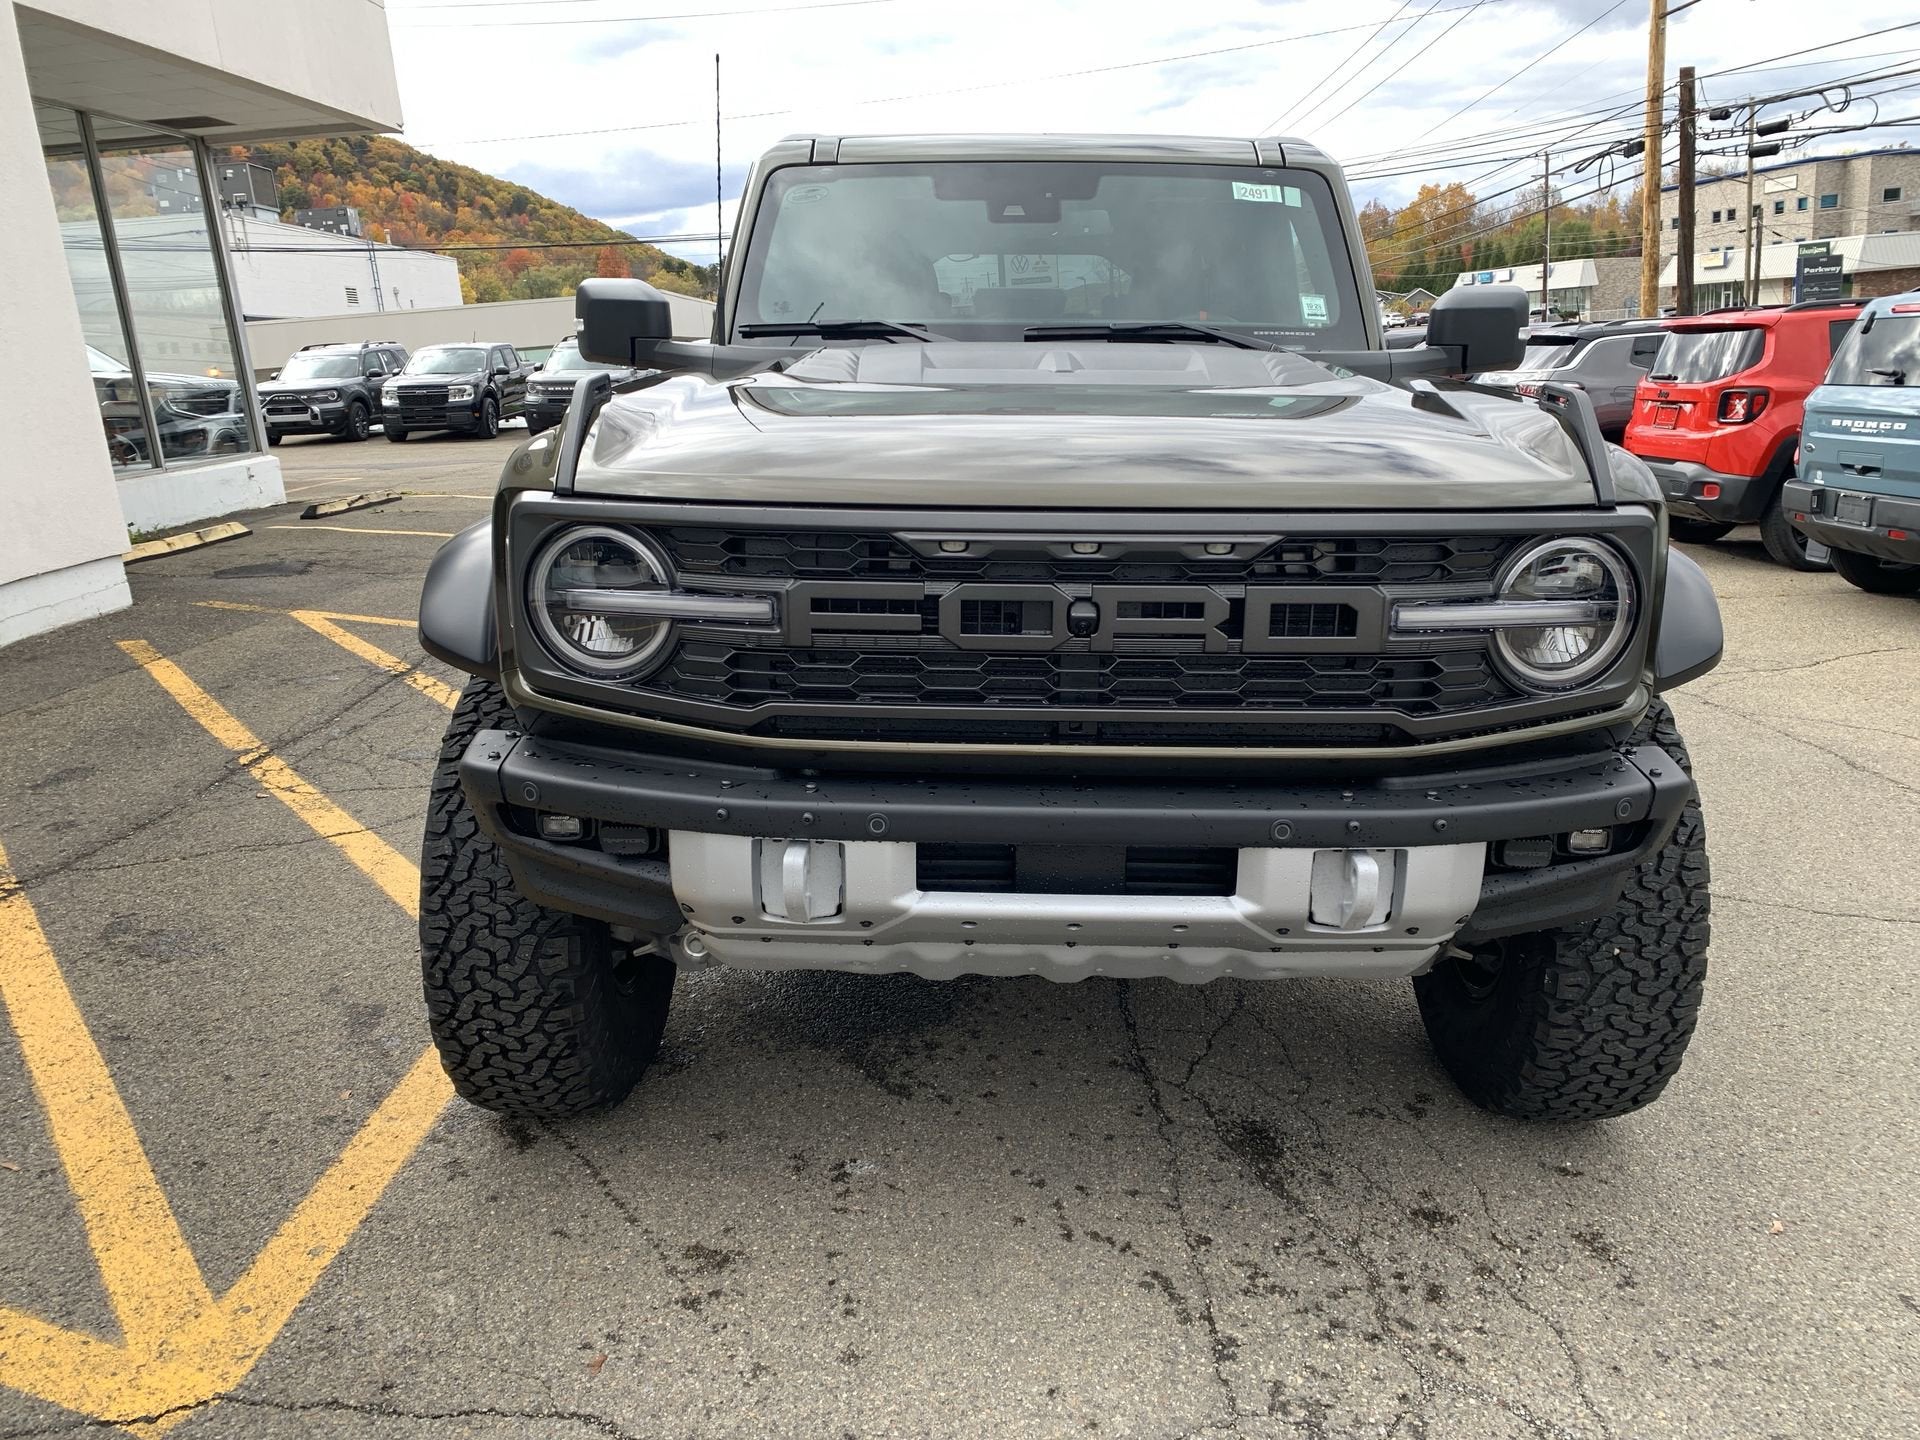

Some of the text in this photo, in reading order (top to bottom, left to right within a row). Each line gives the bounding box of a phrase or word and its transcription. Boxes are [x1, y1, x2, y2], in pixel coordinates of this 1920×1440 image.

[1240, 186, 1269, 200] 2491
[1803, 265, 1842, 274] Parkway
[1831, 419, 1907, 431] BRONCO
[784, 580, 1386, 654] FORD
